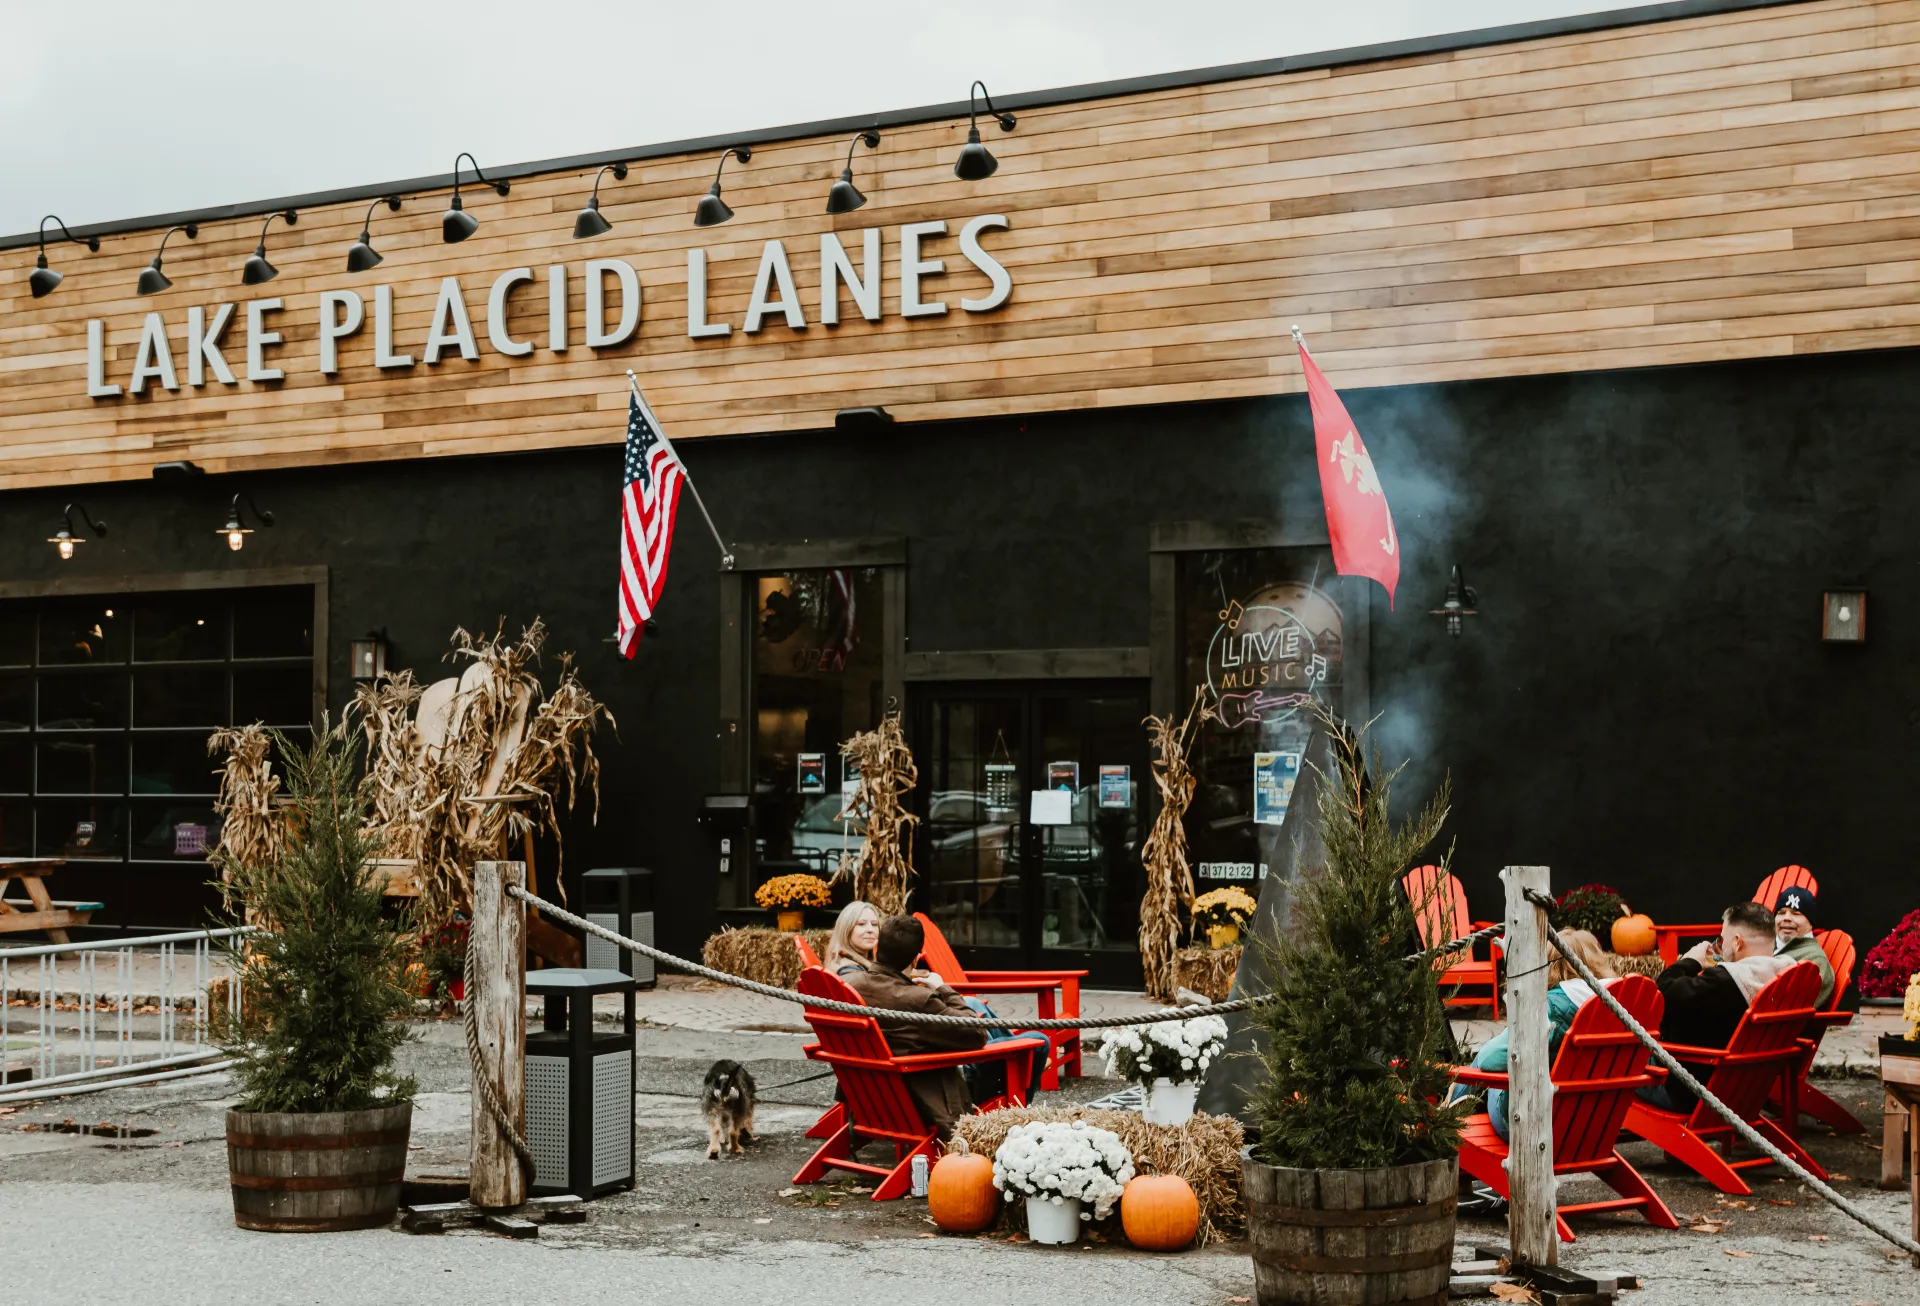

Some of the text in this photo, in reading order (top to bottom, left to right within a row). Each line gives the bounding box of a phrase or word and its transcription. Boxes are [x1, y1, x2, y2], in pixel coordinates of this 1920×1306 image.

[87, 214, 1013, 398] LAKE PLACID LANES
[793, 649, 847, 671] OPEN
[1221, 627, 1299, 668] LIVE
[1221, 662, 1297, 689] MUSIC
